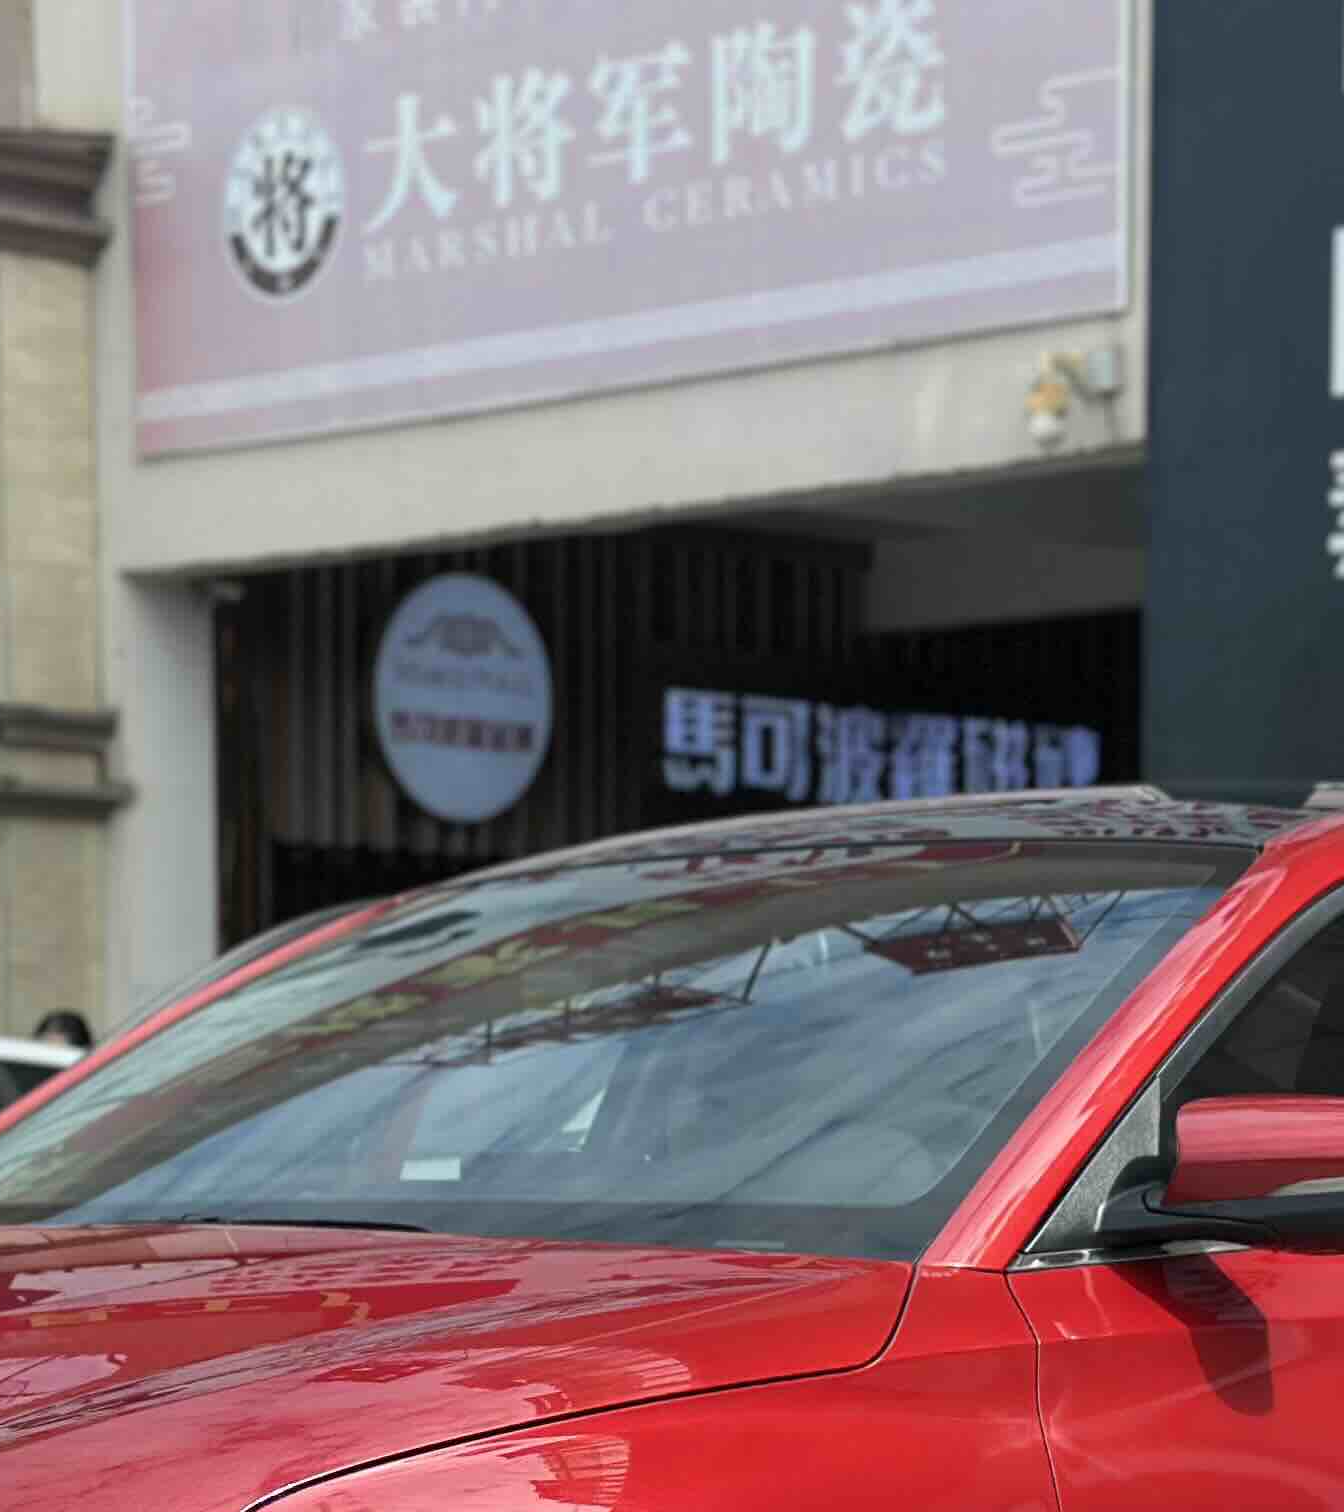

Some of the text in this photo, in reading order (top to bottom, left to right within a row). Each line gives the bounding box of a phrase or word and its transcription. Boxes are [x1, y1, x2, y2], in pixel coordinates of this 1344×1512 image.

[361, 0, 946, 234] 大将军陶瓷
[362, 140, 946, 285] MARSHAL CERAMICS
